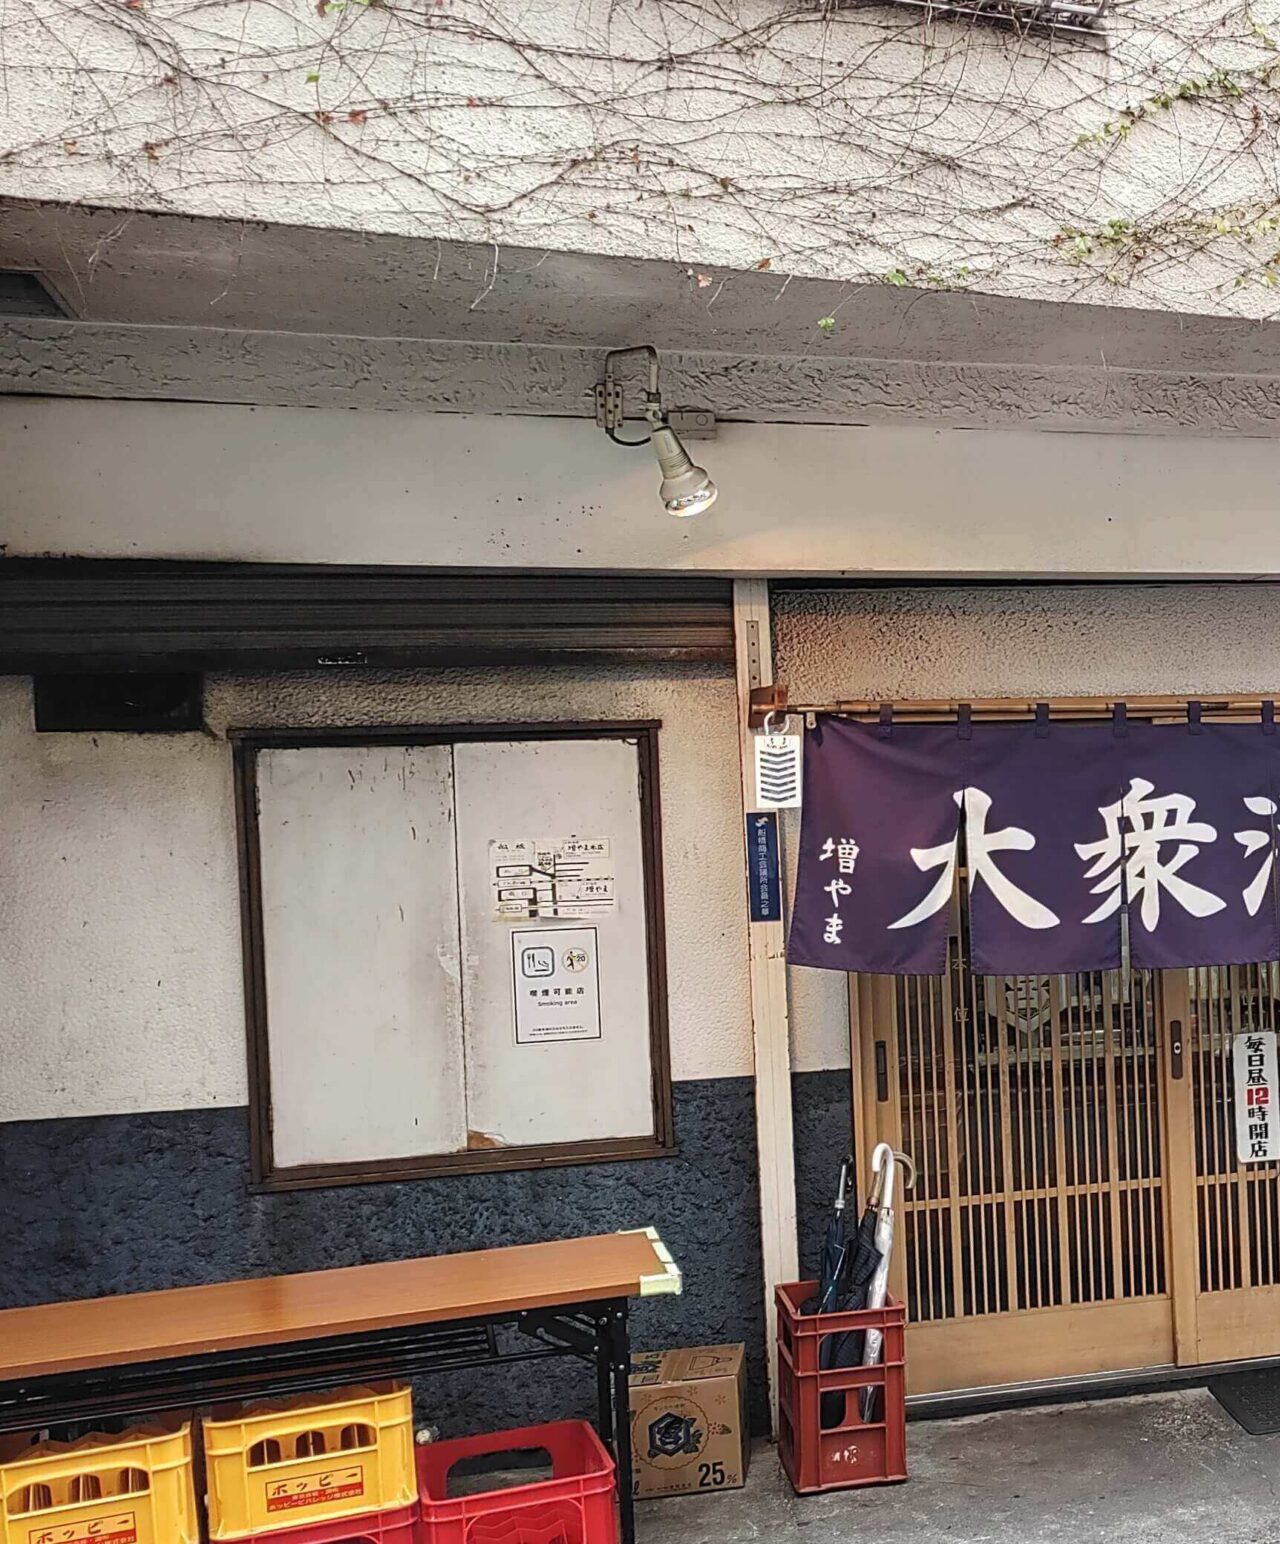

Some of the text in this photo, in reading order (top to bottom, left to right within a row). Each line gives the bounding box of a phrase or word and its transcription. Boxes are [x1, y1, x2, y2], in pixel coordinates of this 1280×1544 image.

[818, 837, 860, 946] 増やま
[1244, 1035, 1270, 1159] 毎日昼12時開店
[271, 1472, 358, 1497] ホッピー
[698, 1461, 725, 1487] 25
